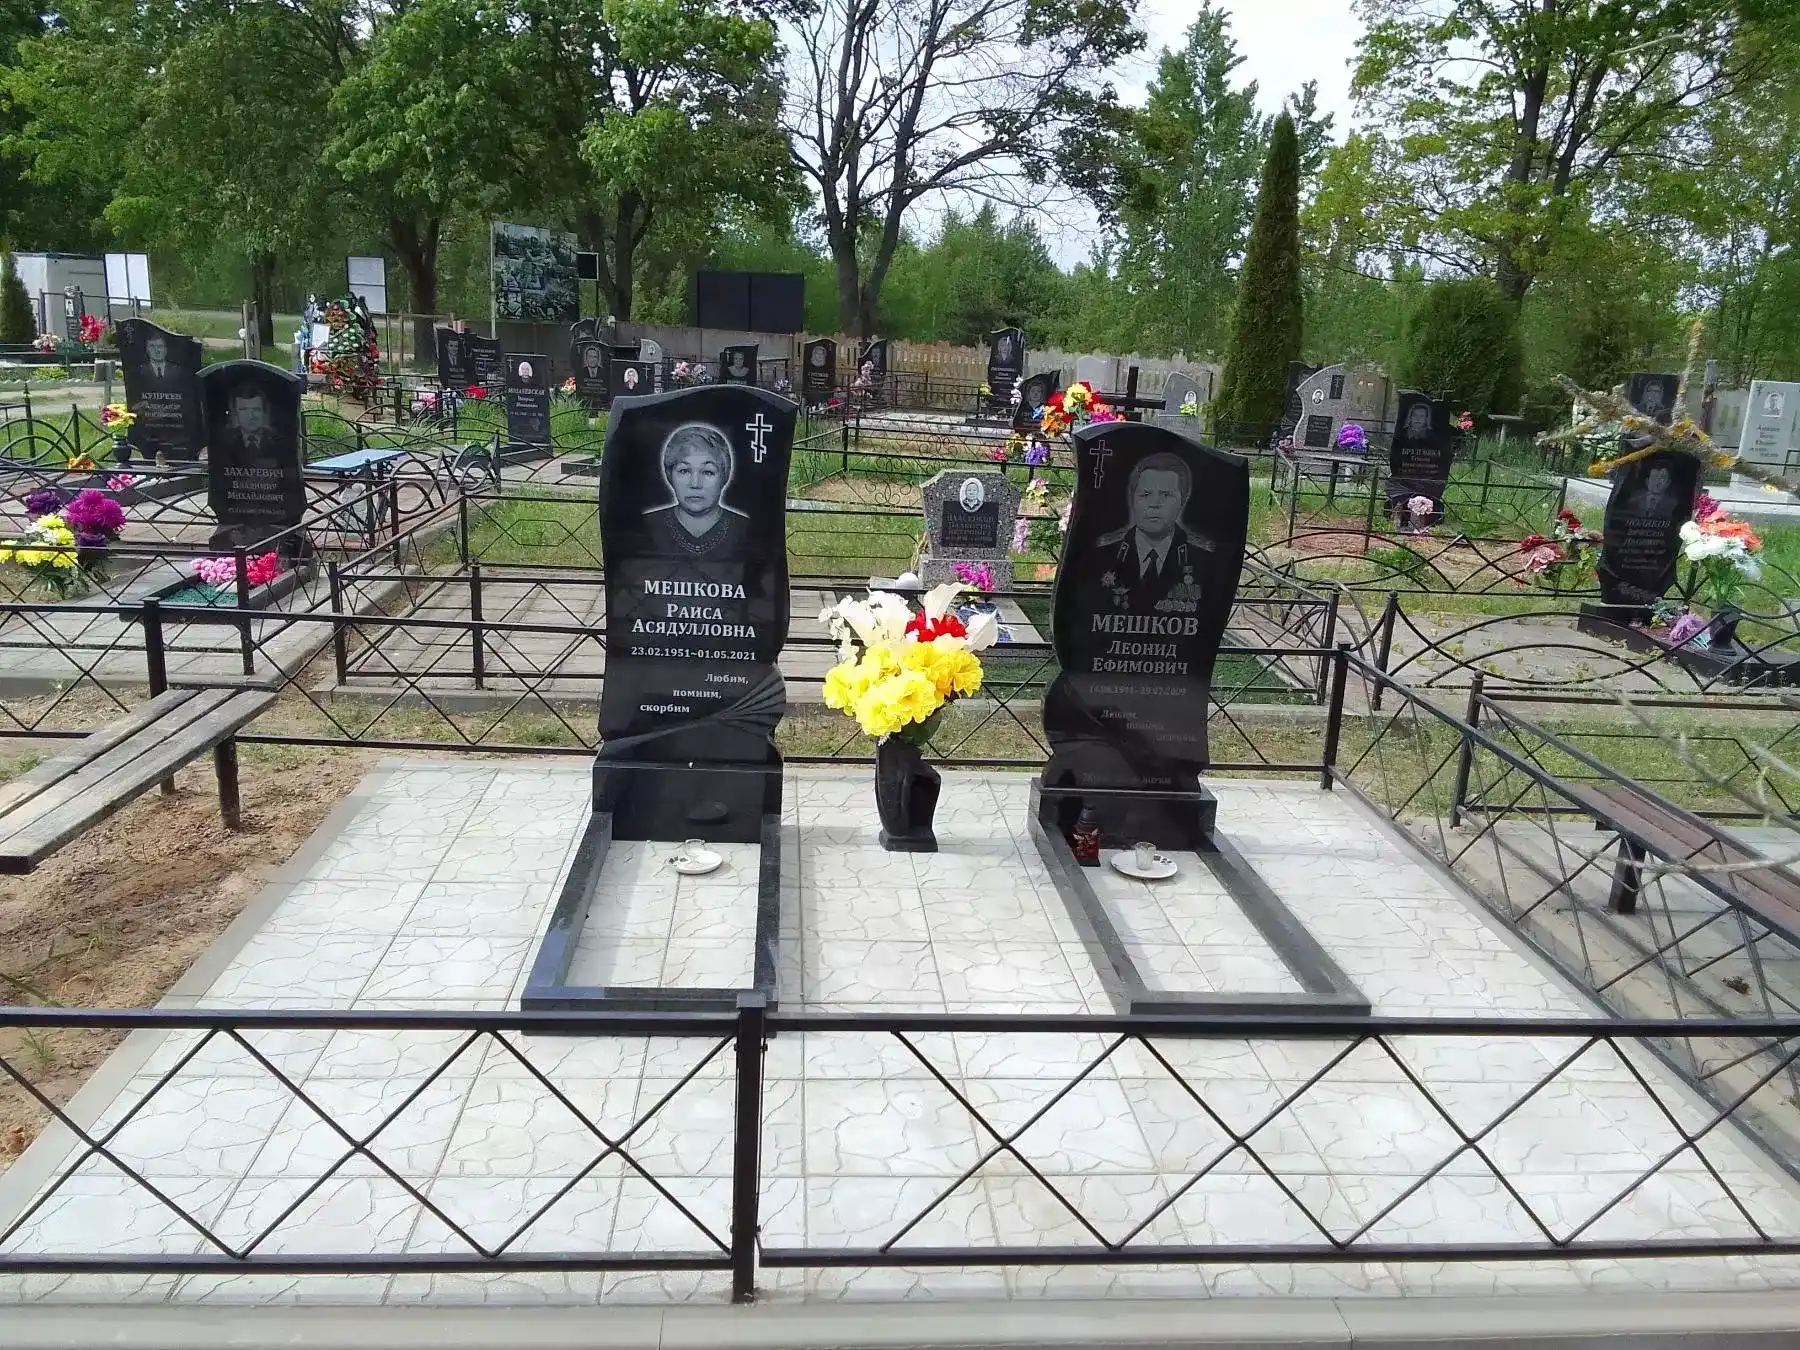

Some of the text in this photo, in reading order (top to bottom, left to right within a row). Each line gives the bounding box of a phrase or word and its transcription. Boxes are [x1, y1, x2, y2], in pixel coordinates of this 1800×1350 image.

[223, 466, 284, 478] ЗАХАРЕВИЧ
[644, 579, 747, 599] МЕШКОВА
[1091, 613, 1200, 636] МЕШКОВ
[704, 673, 750, 685] Любим,
[672, 689, 722, 700] помним,
[639, 703, 690, 715] скорбим
